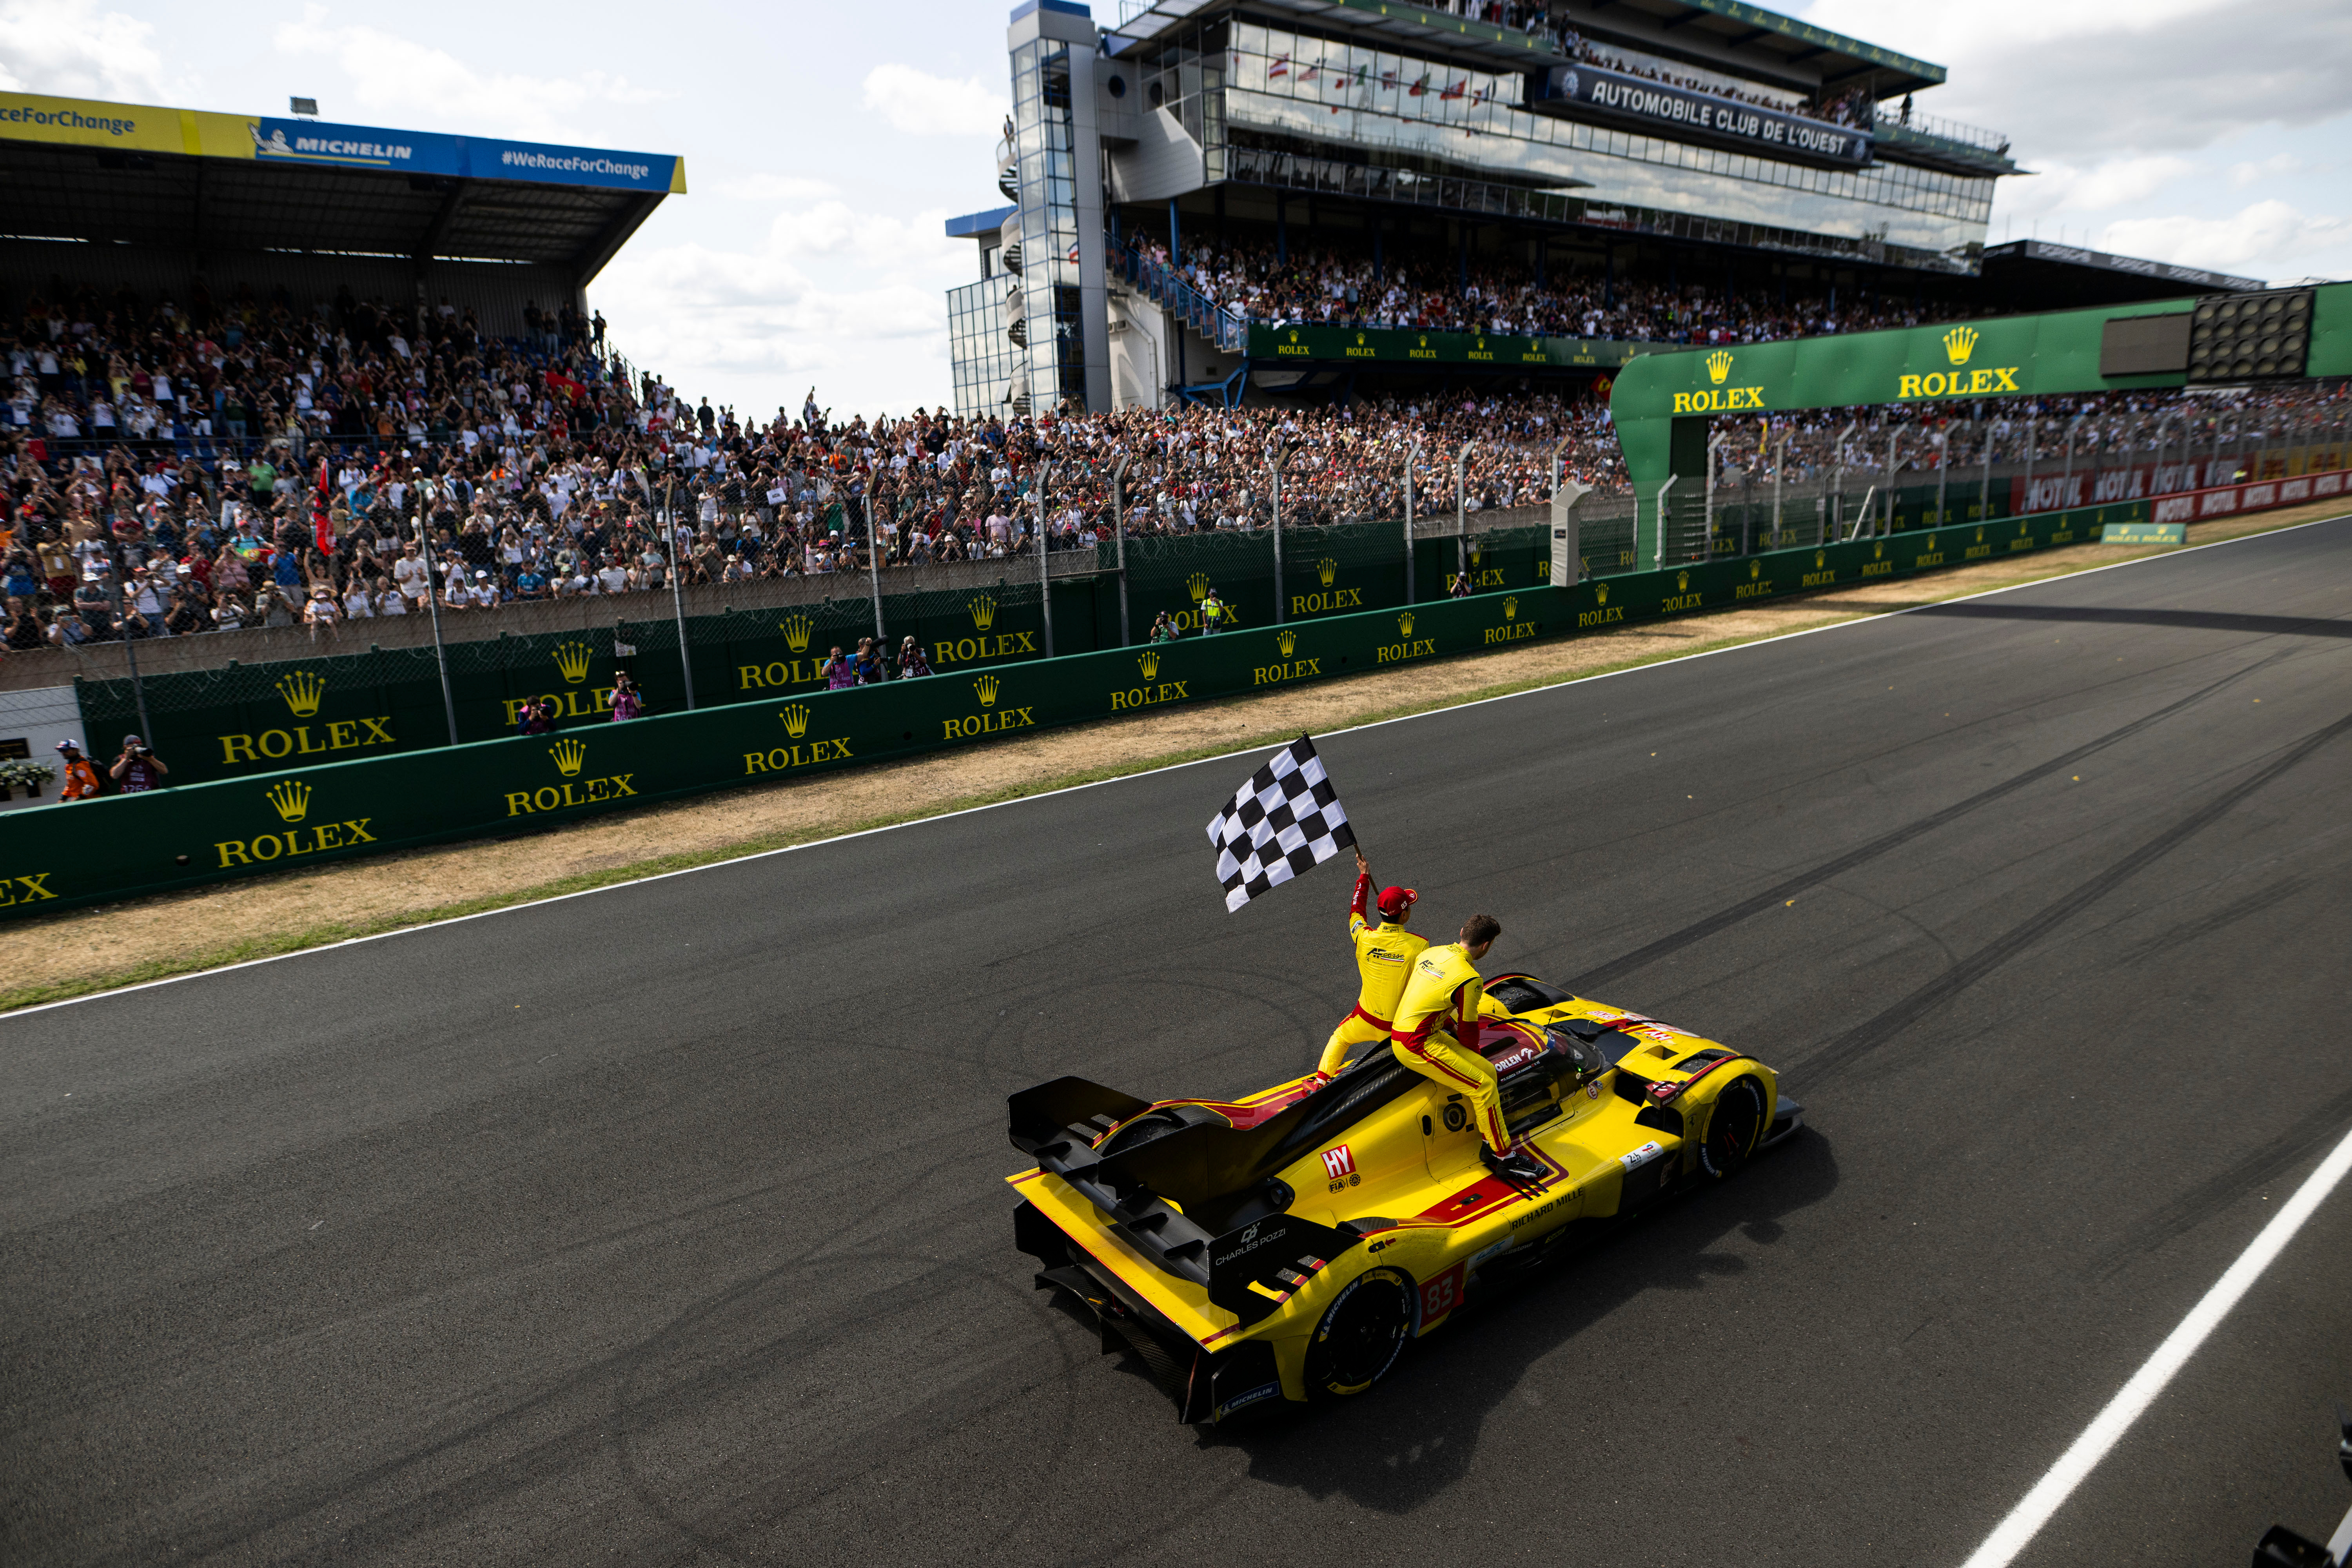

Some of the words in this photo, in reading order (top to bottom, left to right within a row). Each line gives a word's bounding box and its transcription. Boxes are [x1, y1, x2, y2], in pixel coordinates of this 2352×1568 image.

[0, 107, 135, 136] ceForChange
[1592, 81, 1712, 127] AUTOMOBILE
[1715, 108, 1759, 136] CLUB
[1762, 118, 1784, 142] DE
[1787, 124, 1846, 154] L'OUEST
[296, 136, 412, 160] MICHELIN
[502, 151, 650, 179] #WeRaceForChange
[1279, 345, 1309, 354] ROLEX
[1347, 348, 1375, 356] ROLEX
[1410, 349, 1436, 358] ROLEX
[1468, 351, 1493, 359] ROLEX
[1523, 353, 1546, 361] ROLEX
[1899, 368, 2018, 397] ROLEX
[1674, 387, 1764, 412] ROLEX
[1863, 561, 1892, 577] ROLEX
[1916, 552, 1943, 567] ROLEX
[1803, 571, 1835, 586] ROLEX
[1292, 588, 1362, 614] ROLEX
[1662, 593, 1701, 612] ROLEX
[1579, 606, 1623, 627] ROLEX
[1485, 622, 1535, 644] ROLEX
[935, 632, 1036, 663] ROLEX
[1377, 639, 1435, 663] ROLEX
[1254, 659, 1321, 685] ROLEX
[1111, 681, 1189, 710] ROLEX
[943, 707, 1034, 740] ROLEX
[218, 717, 396, 763] ROLEX
[743, 737, 853, 774] ROLEX
[505, 774, 637, 816] ROLEX
[214, 818, 377, 867] ROLEX
[1401, 900, 1407, 909] 83
[1428, 966, 1446, 975] corse
[1495, 1054, 1523, 1072] ORLEN
[1662, 1096, 1675, 1105] ORLEN
[1322, 1146, 1350, 1178] HY
[1702, 1147, 1715, 1174] MICHELIN
[1512, 1202, 1553, 1230] RICHARD
[1556, 1187, 1583, 1208] MILLE
[1216, 1240, 1258, 1266] CHARLES
[1259, 1229, 1286, 1247] POZZI
[1327, 1281, 1358, 1324] MICHELIN
[1427, 1275, 1454, 1315] 83
[1232, 1387, 1272, 1407] MICHELIN
